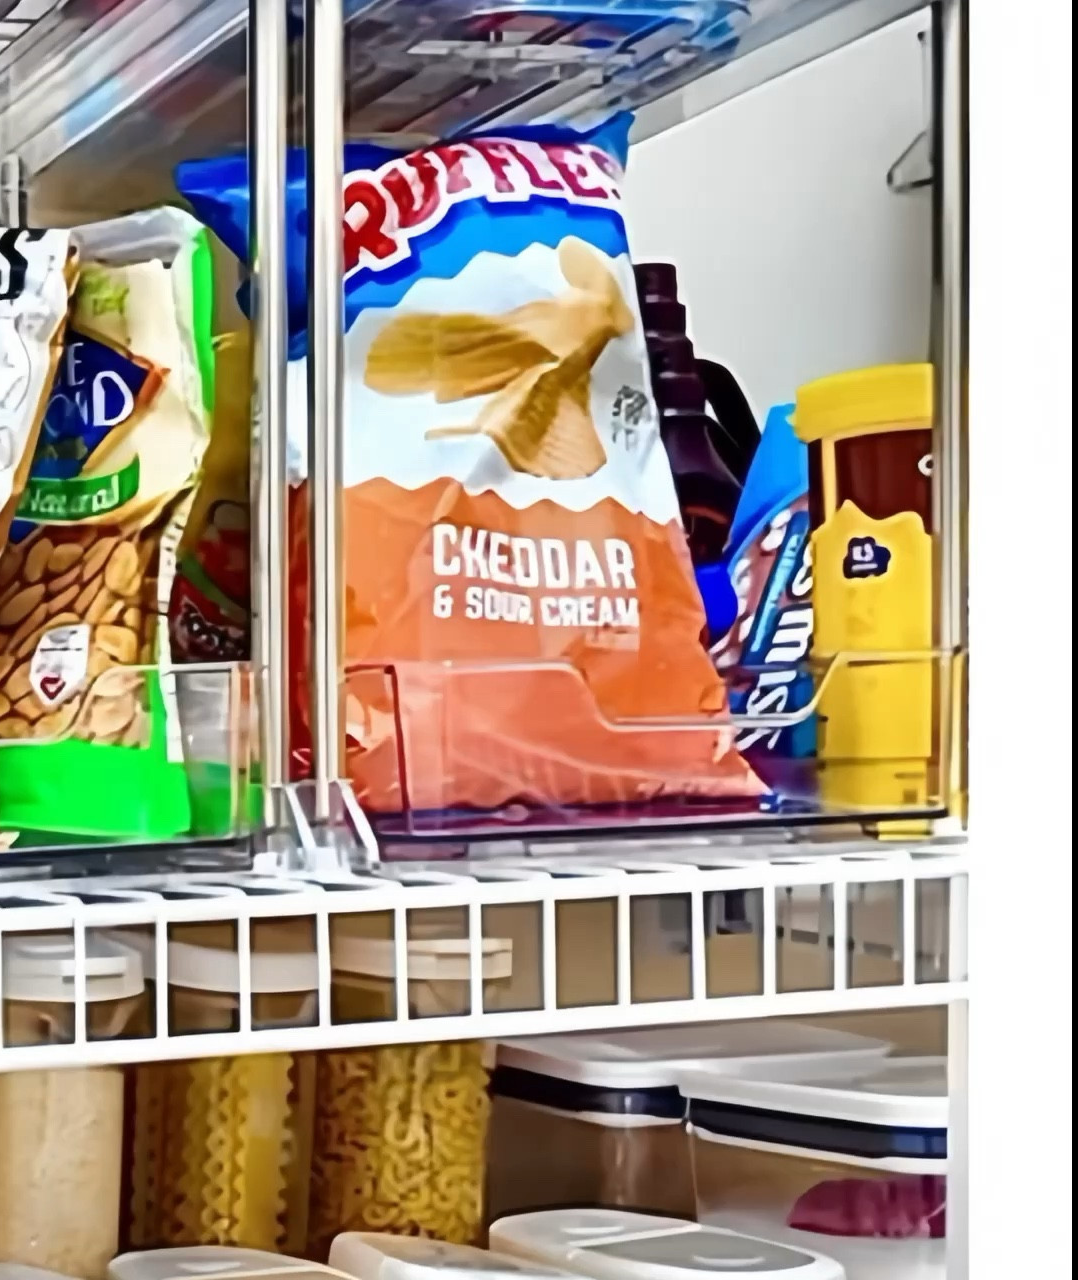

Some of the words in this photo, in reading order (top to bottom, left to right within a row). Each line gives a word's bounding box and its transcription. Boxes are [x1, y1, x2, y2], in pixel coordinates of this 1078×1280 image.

[432, 523, 638, 590] CHEDDAR
[432, 583, 455, 619] &
[465, 585, 535, 625] SOUR
[540, 596, 641, 628] CREAM
